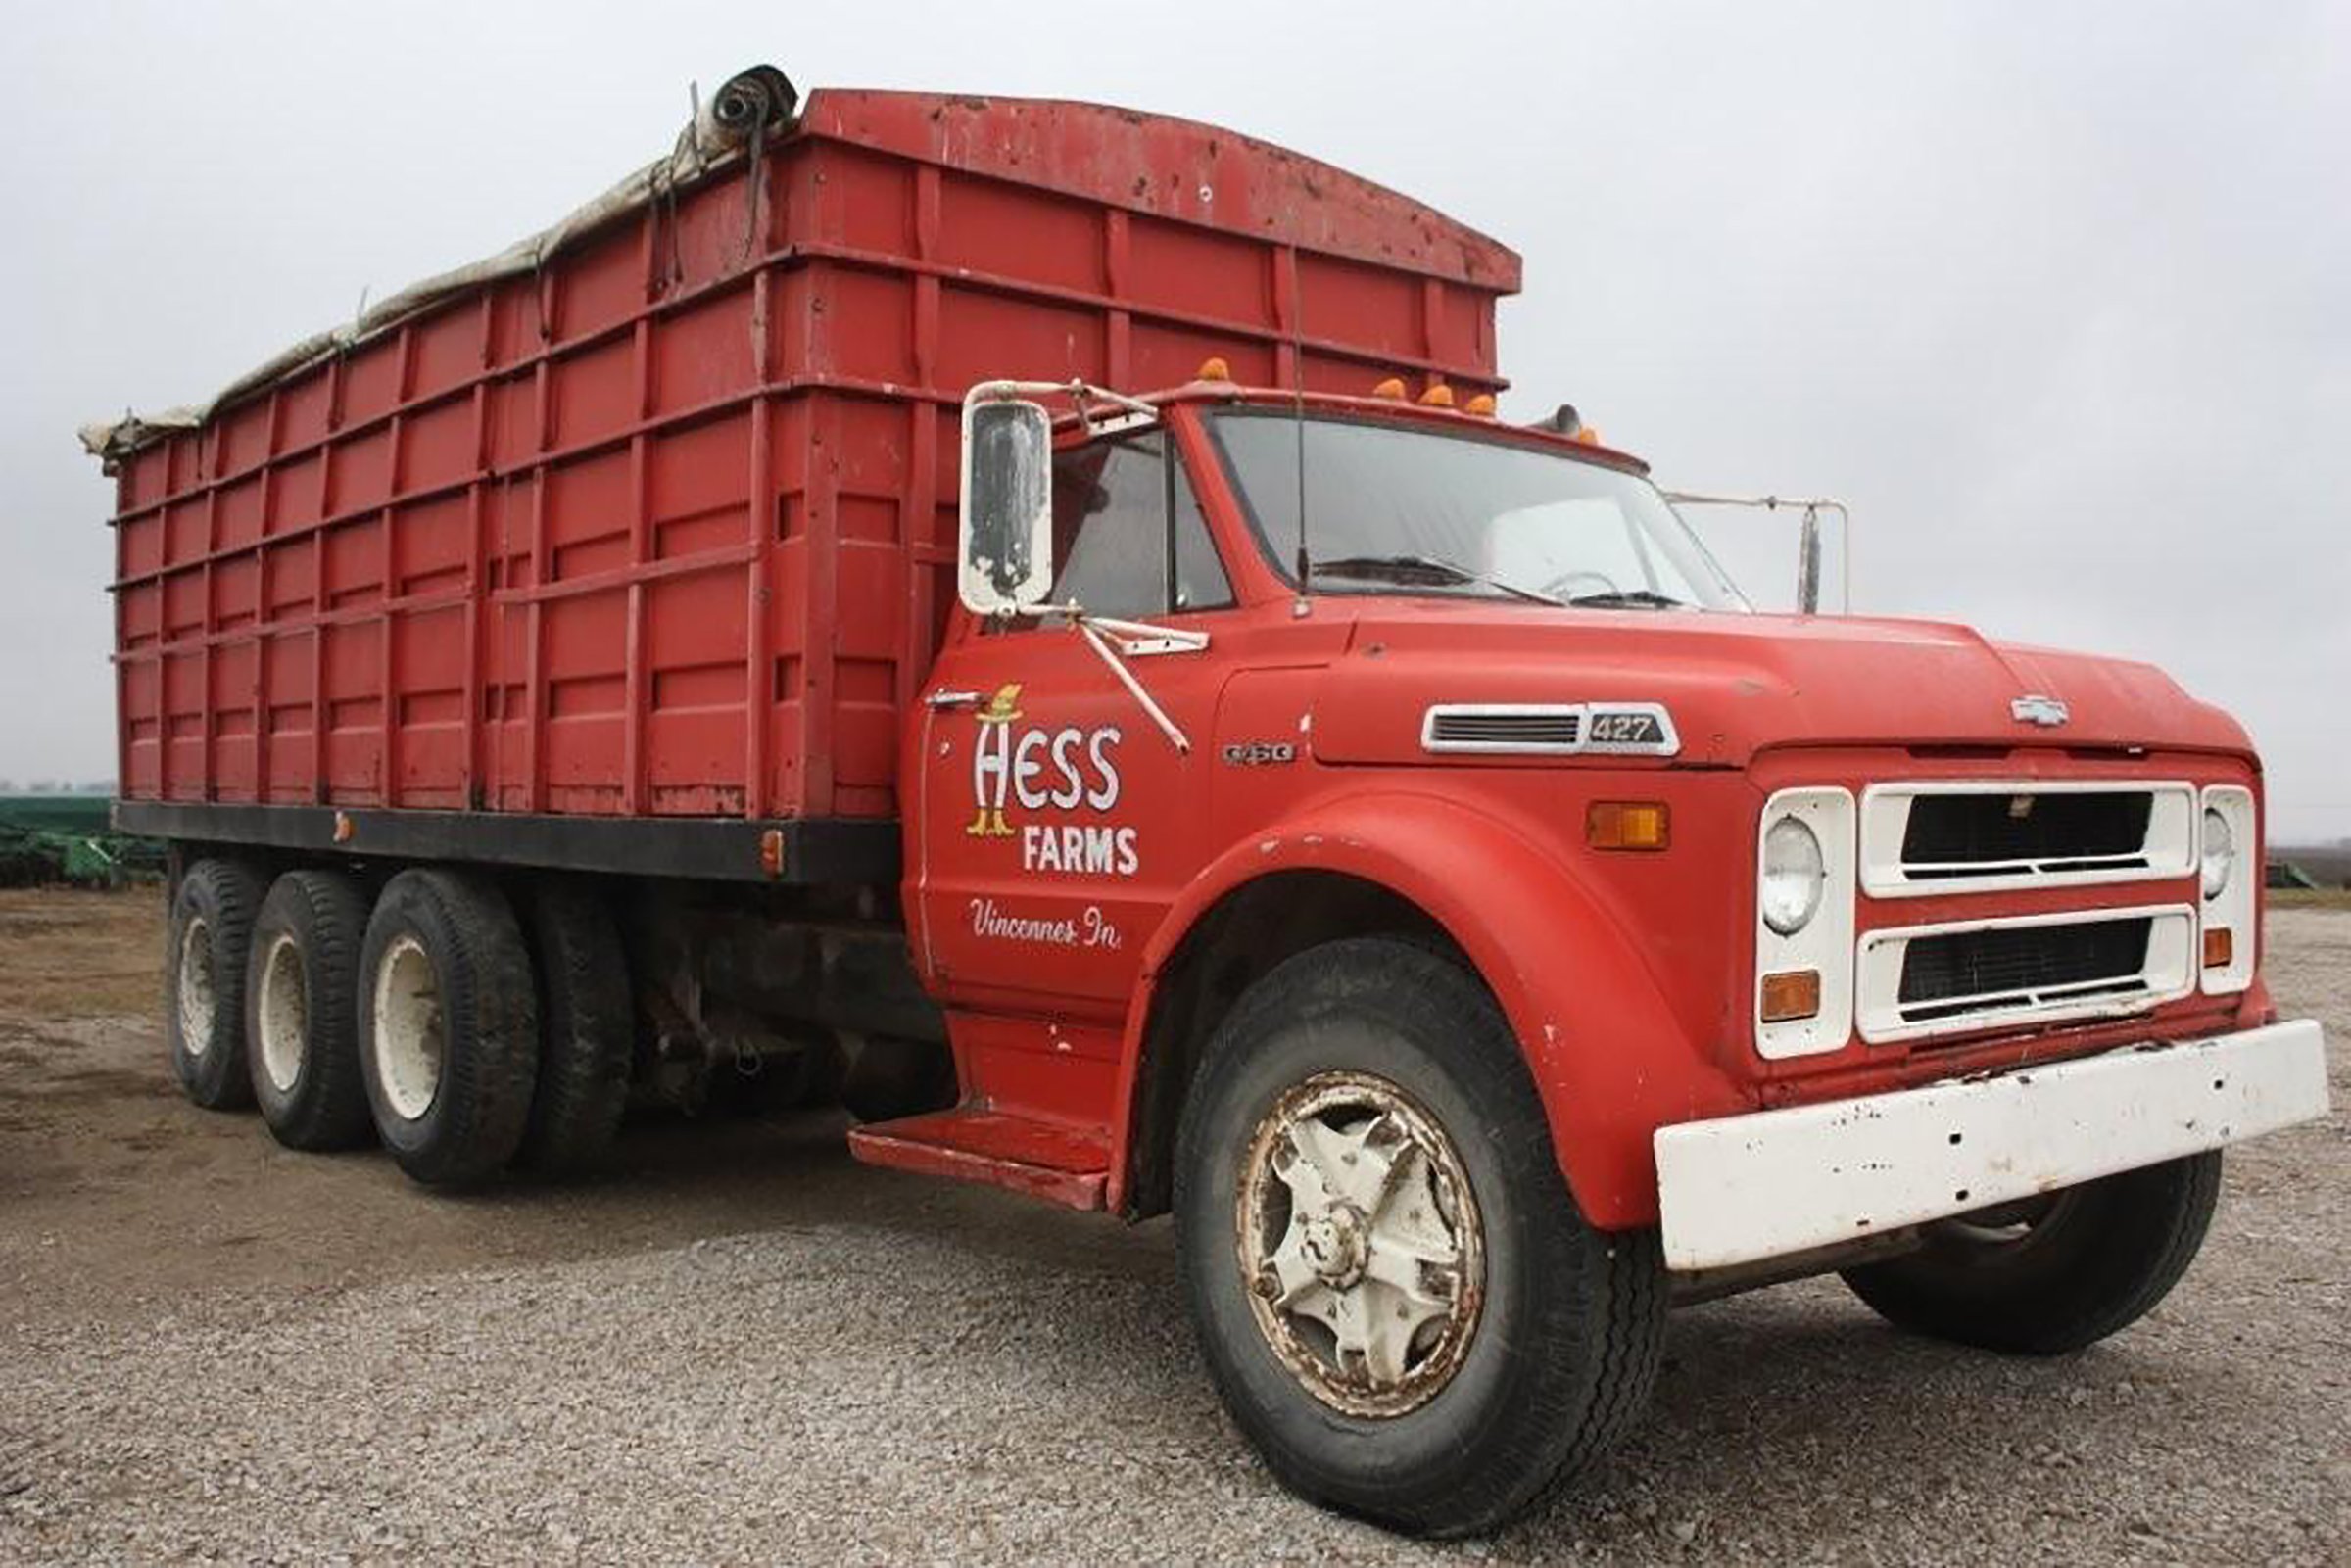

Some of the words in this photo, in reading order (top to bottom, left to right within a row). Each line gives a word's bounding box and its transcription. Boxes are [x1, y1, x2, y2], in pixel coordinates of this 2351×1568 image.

[1593, 716, 1652, 741] 427
[973, 717, 1122, 815] HESS
[1023, 826, 1138, 874] FARMS
